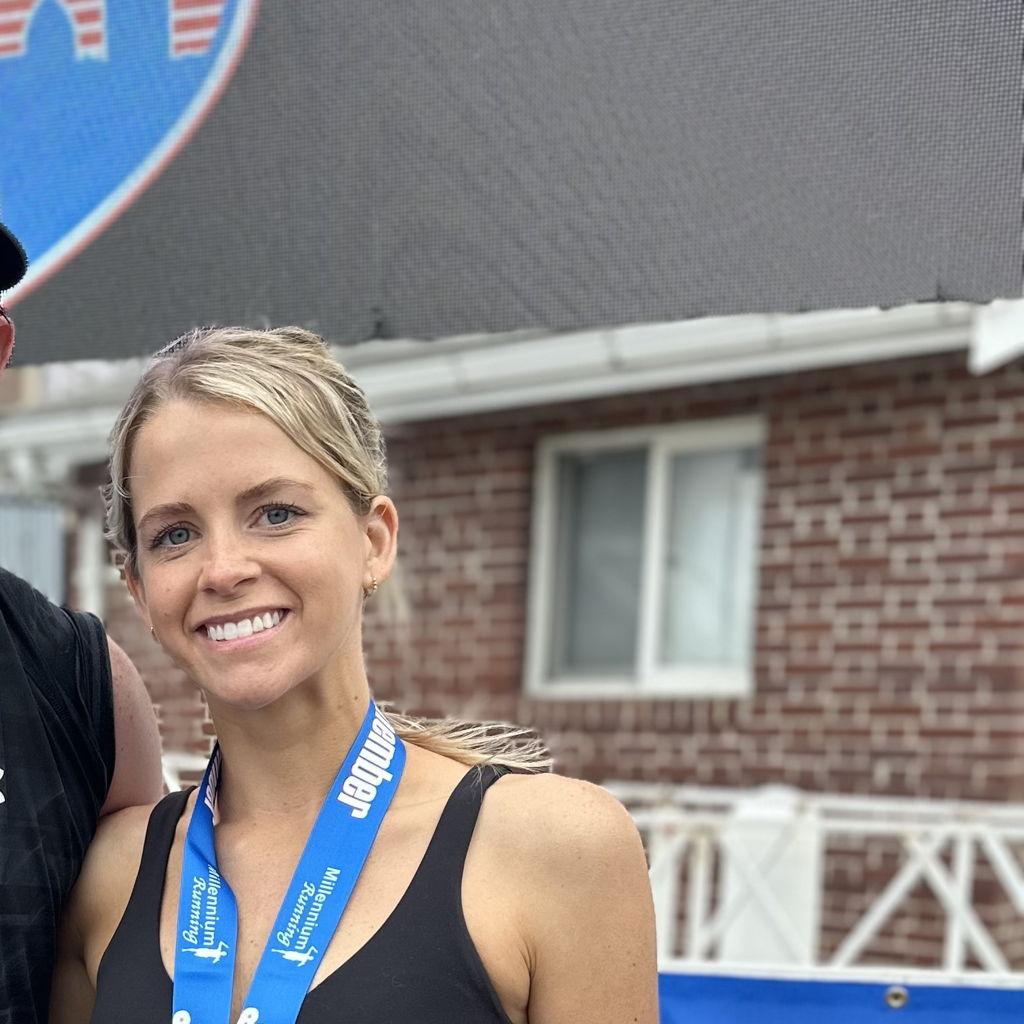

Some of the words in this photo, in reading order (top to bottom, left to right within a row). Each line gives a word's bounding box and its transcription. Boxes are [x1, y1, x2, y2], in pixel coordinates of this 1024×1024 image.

[182, 876, 207, 945] Running
[277, 881, 315, 947] Running
[293, 867, 341, 950] Millennium
